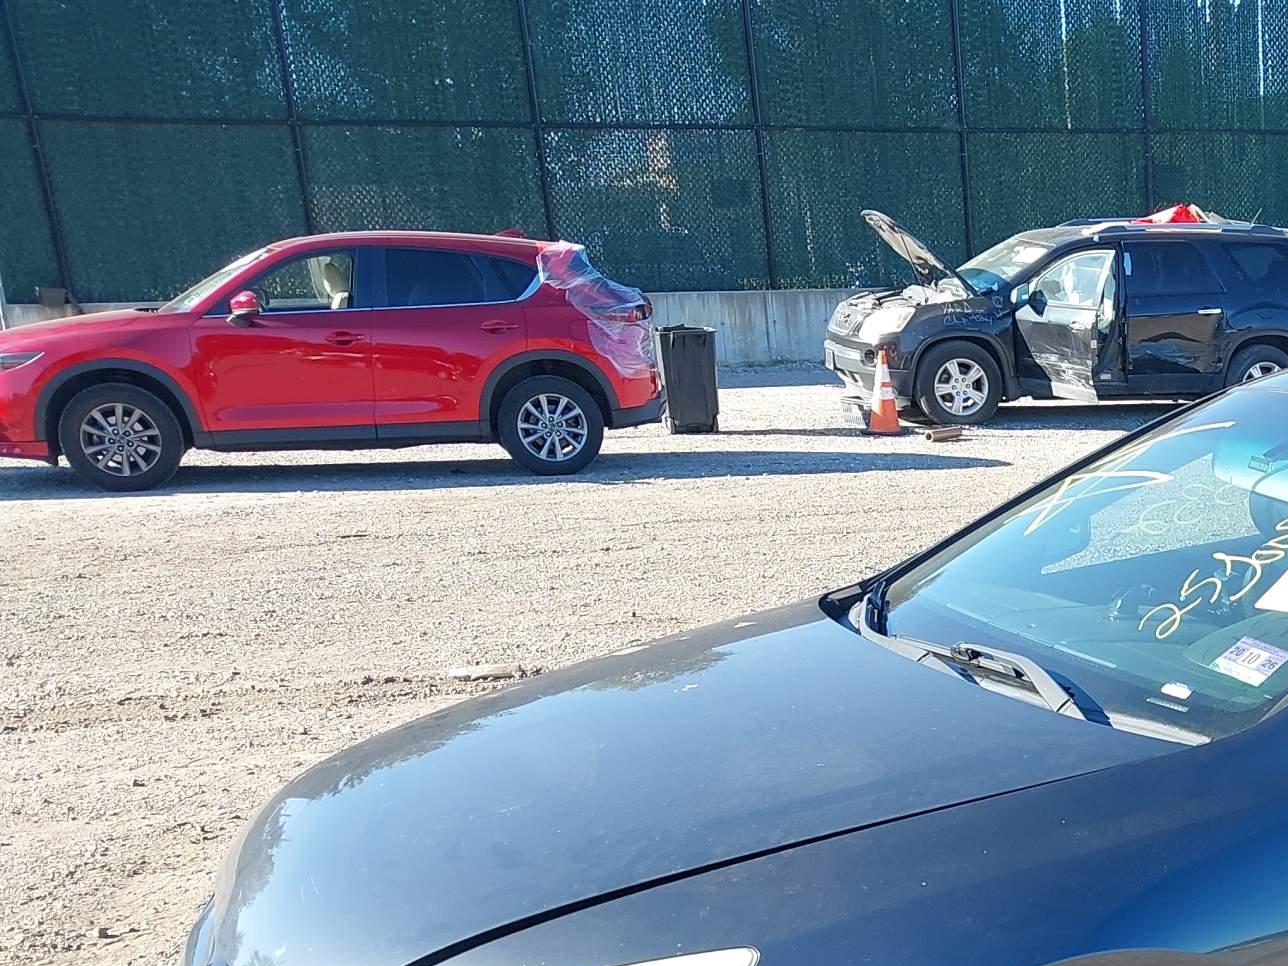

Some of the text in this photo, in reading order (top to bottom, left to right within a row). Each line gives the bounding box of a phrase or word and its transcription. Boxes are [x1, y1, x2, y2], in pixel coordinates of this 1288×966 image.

[1231, 647, 1279, 670] 20 10 26
